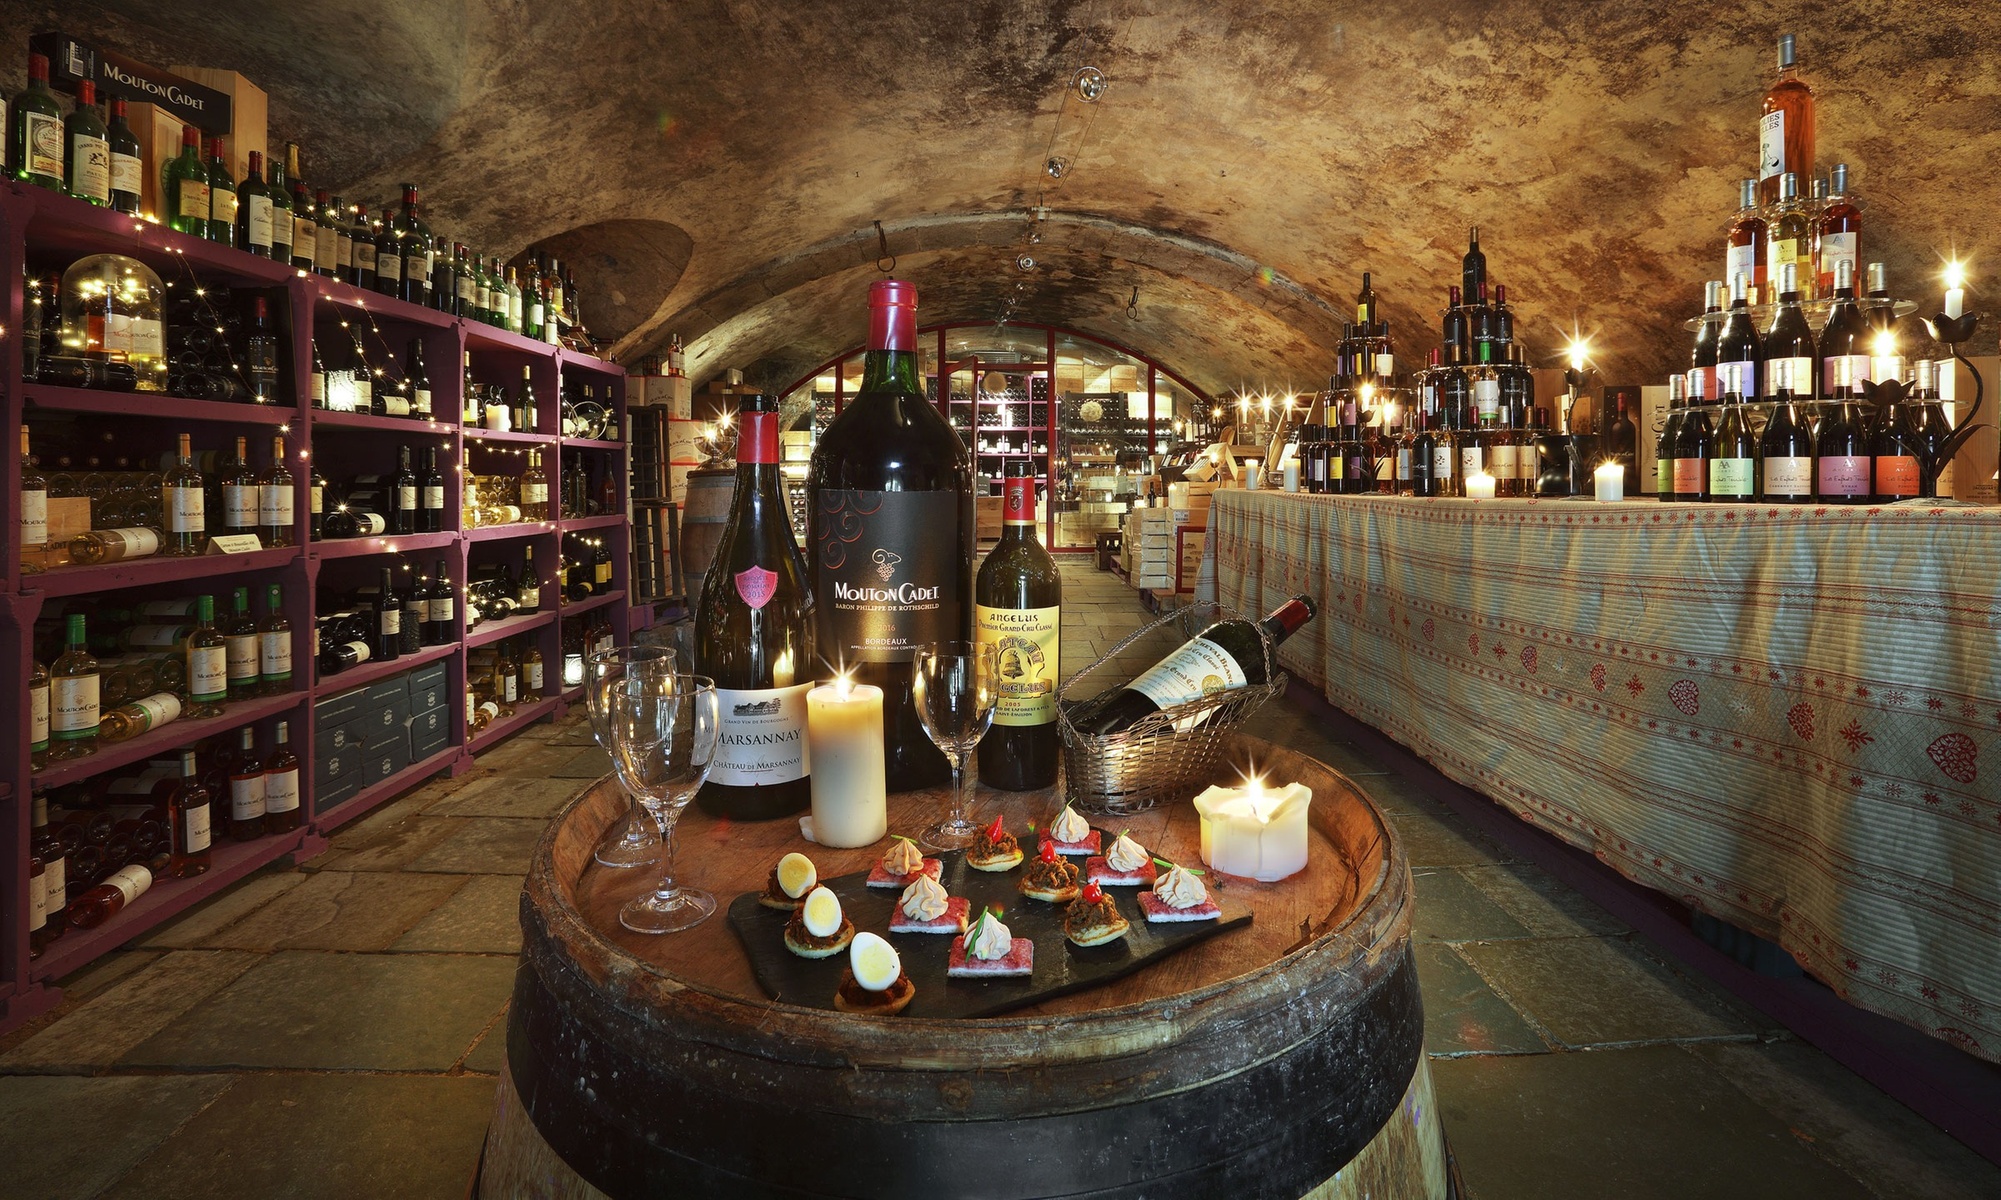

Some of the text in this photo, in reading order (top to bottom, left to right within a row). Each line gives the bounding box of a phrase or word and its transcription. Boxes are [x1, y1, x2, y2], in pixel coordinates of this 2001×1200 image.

[898, 603, 939, 611] ROTHSCHILD
[990, 613, 1039, 623] ANGELUS
[865, 638, 908, 646] BORDEAUX
[1195, 640, 1235, 687] CHEVAL BLANC
[760, 716, 789, 724] BOURGOGNE
[713, 759, 746, 770] CHÂTEAU
[756, 756, 801, 770] MARSANNAY
